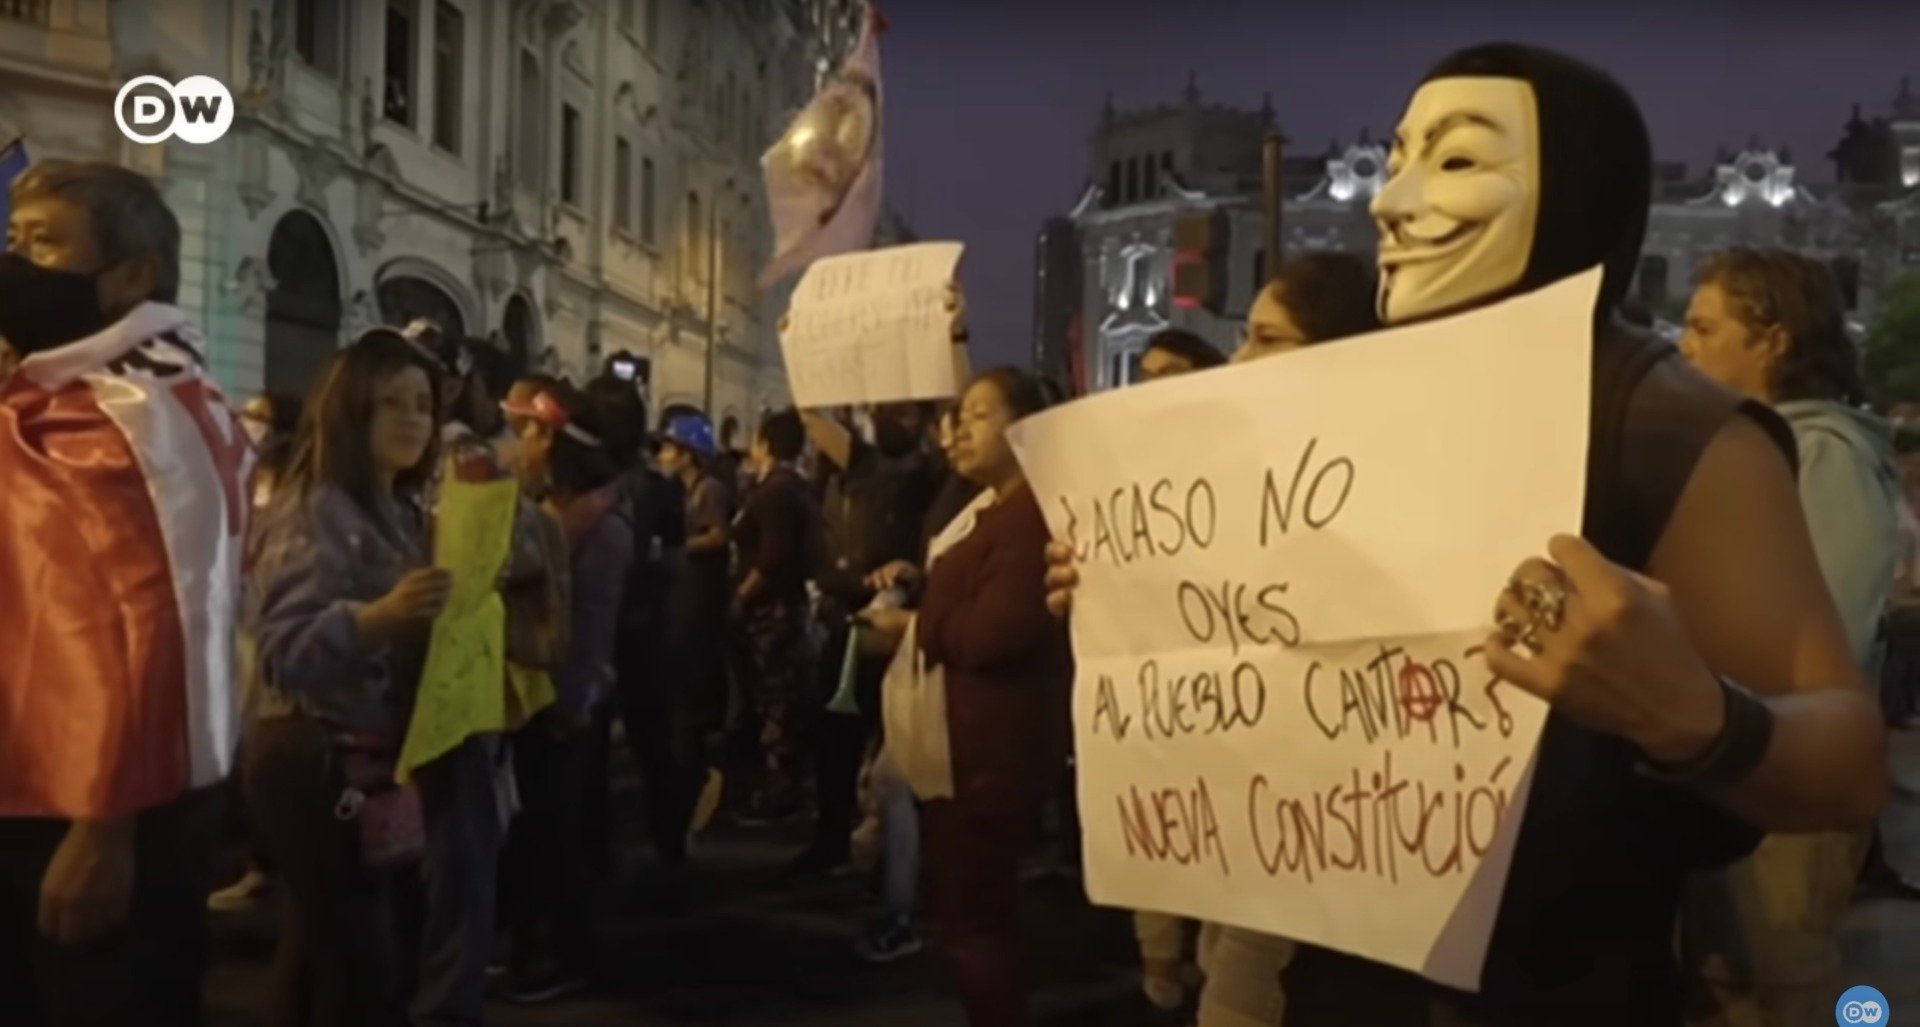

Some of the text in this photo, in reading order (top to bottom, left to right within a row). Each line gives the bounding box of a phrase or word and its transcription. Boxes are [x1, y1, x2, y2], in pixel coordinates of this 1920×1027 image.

[1258, 437, 1355, 547] NO
[1176, 580, 1299, 656] OYES
[1093, 674, 1131, 742] AL
[1138, 659, 1266, 740] PUEBLO
[1116, 775, 1231, 877] NUEVA
